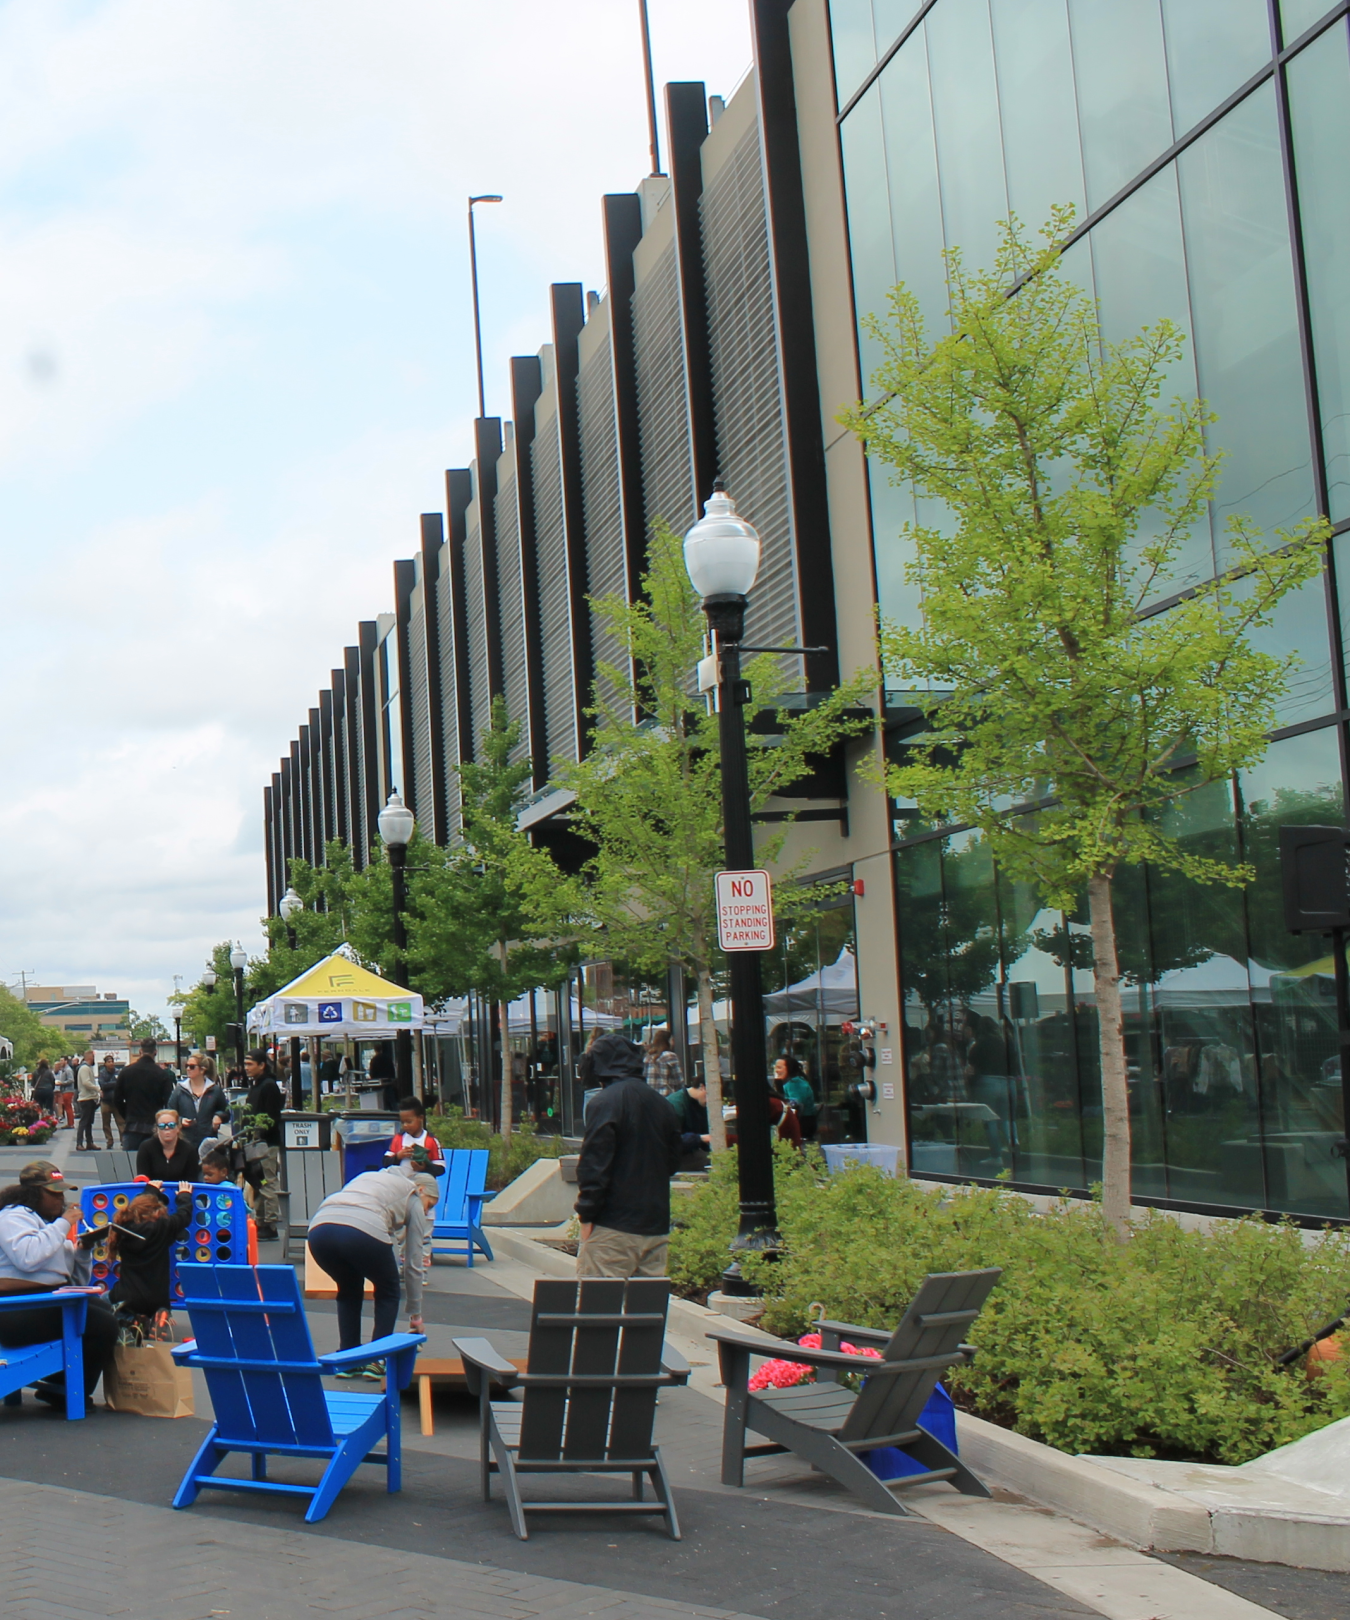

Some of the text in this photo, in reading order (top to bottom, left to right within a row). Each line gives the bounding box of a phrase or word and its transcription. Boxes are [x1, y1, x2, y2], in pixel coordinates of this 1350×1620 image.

[731, 880, 754, 897] NO
[722, 904, 767, 916] STOPPING
[722, 917, 768, 929] STANDING
[725, 930, 766, 941] PARKING
